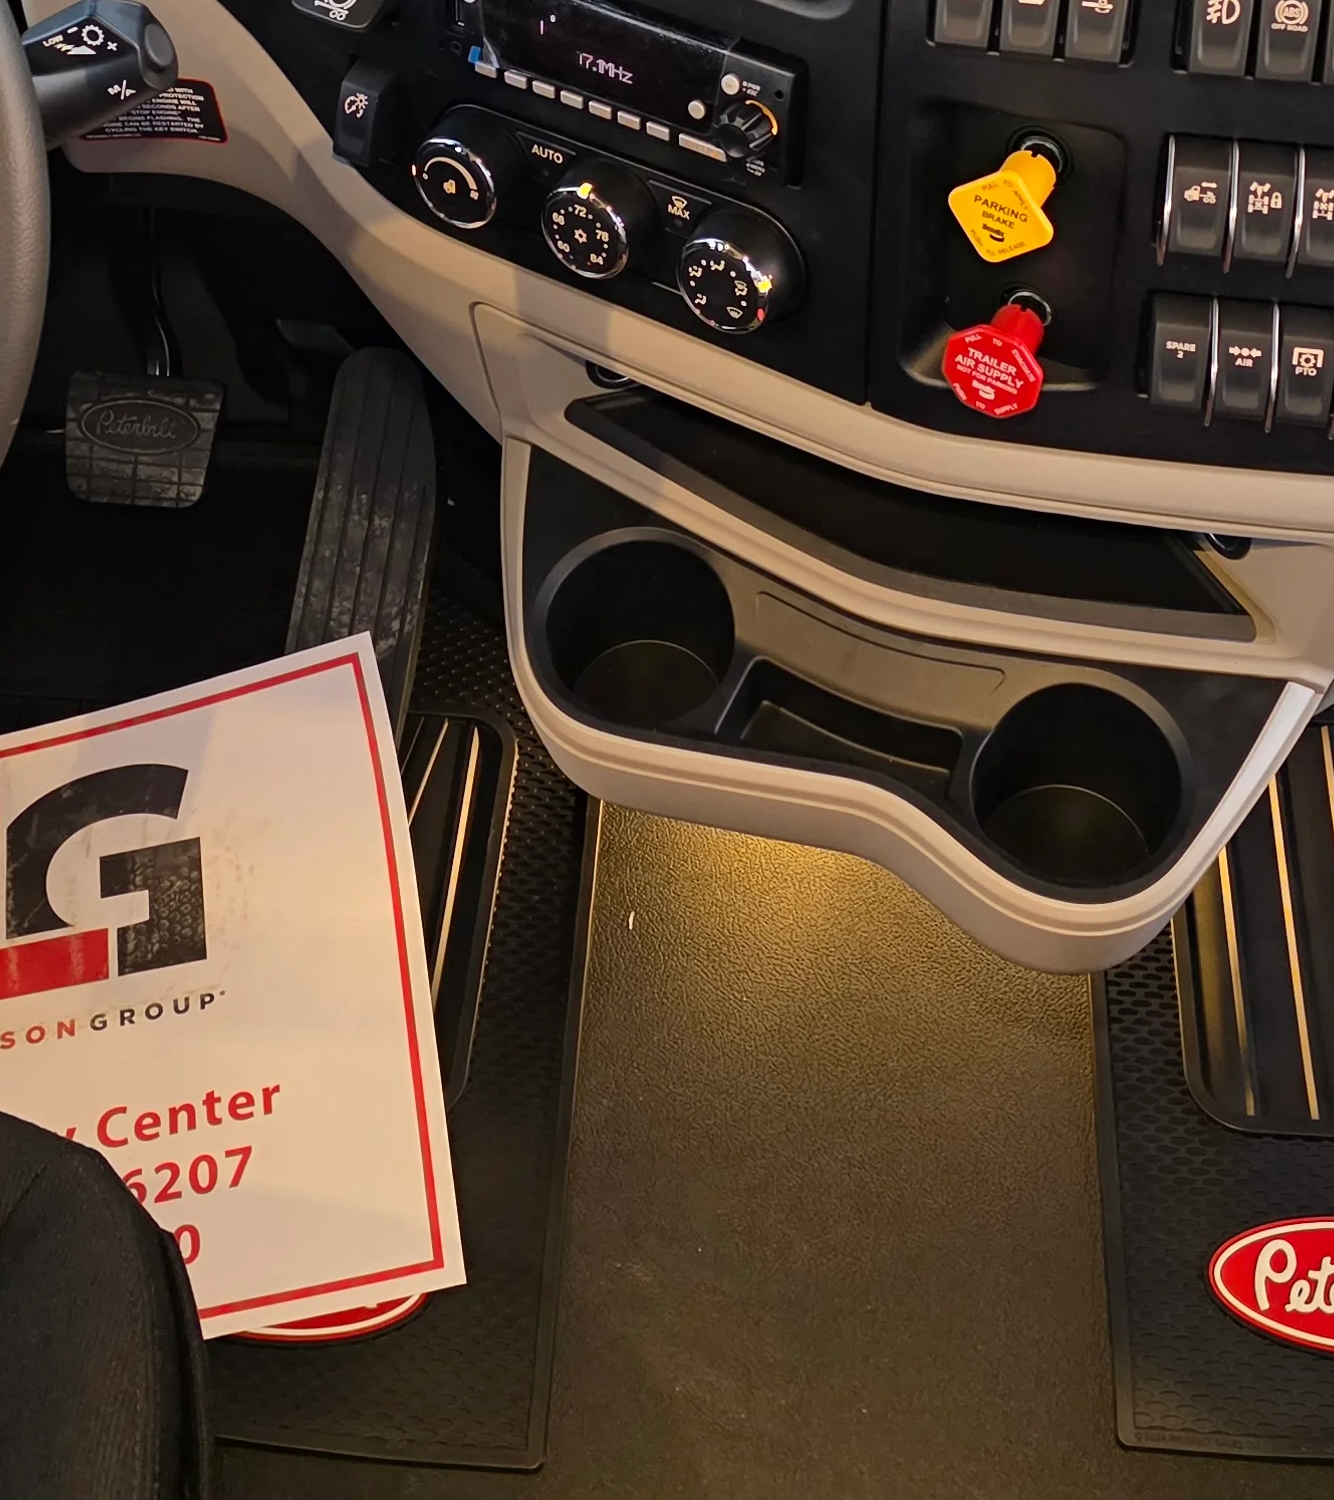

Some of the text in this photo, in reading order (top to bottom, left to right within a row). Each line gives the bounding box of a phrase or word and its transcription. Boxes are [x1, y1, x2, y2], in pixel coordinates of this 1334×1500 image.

[1283, 7, 1301, 18] ABS
[42, 34, 64, 47] LOW
[531, 143, 564, 164] AUTO
[574, 204, 587, 218] 72
[668, 204, 690, 220] MAX
[973, 194, 1028, 223] PARKING
[982, 210, 1015, 229] BRAKE
[992, 338, 1003, 347] TO
[1166, 340, 1196, 352] SPARE
[968, 347, 1017, 377] TRAILER
[1177, 350, 1184, 358] 2
[1235, 358, 1253, 368] AIR
[955, 354, 976, 368] AIR
[976, 364, 1024, 389] SUPPLY
[956, 364, 972, 375] NOT
[972, 370, 986, 381] FOR
[986, 376, 1018, 395] PARKING
[1295, 367, 1317, 377] PTO
[95, 410, 186, 441] Peterbilt
[97, 1083, 281, 1148] Center
